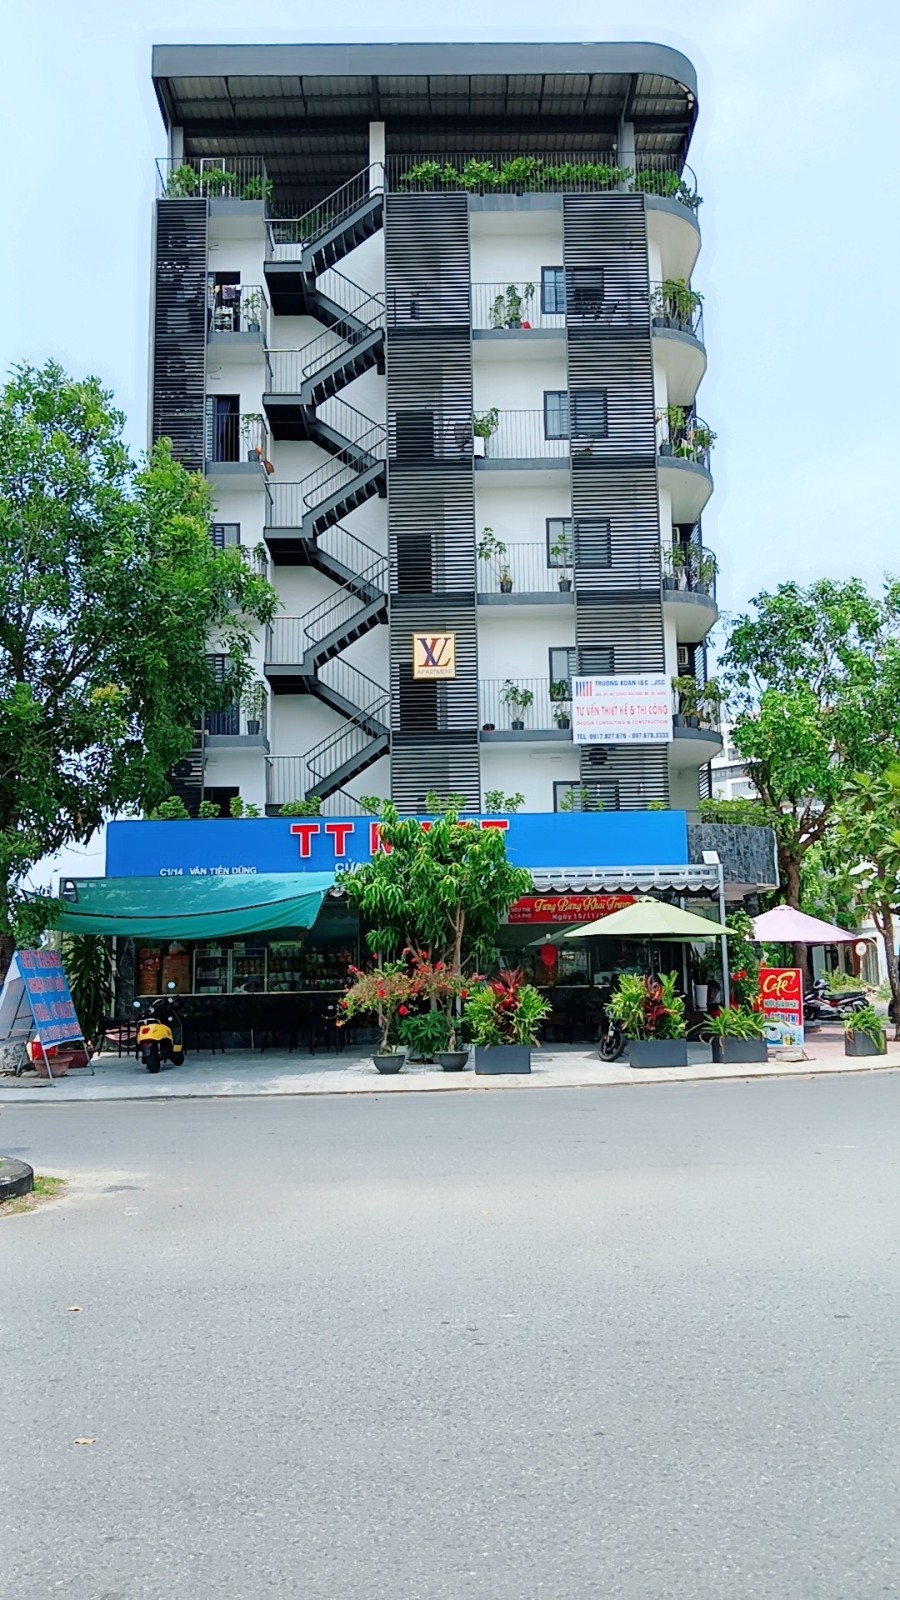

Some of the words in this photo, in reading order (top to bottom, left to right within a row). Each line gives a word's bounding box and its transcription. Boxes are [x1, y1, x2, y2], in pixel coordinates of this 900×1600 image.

[630, 705, 635, 716] &
[648, 702, 669, 715] CÔNG
[289, 822, 355, 858] TT
[160, 868, 184, 876] C1/14
[231, 865, 257, 874] DŨNG
